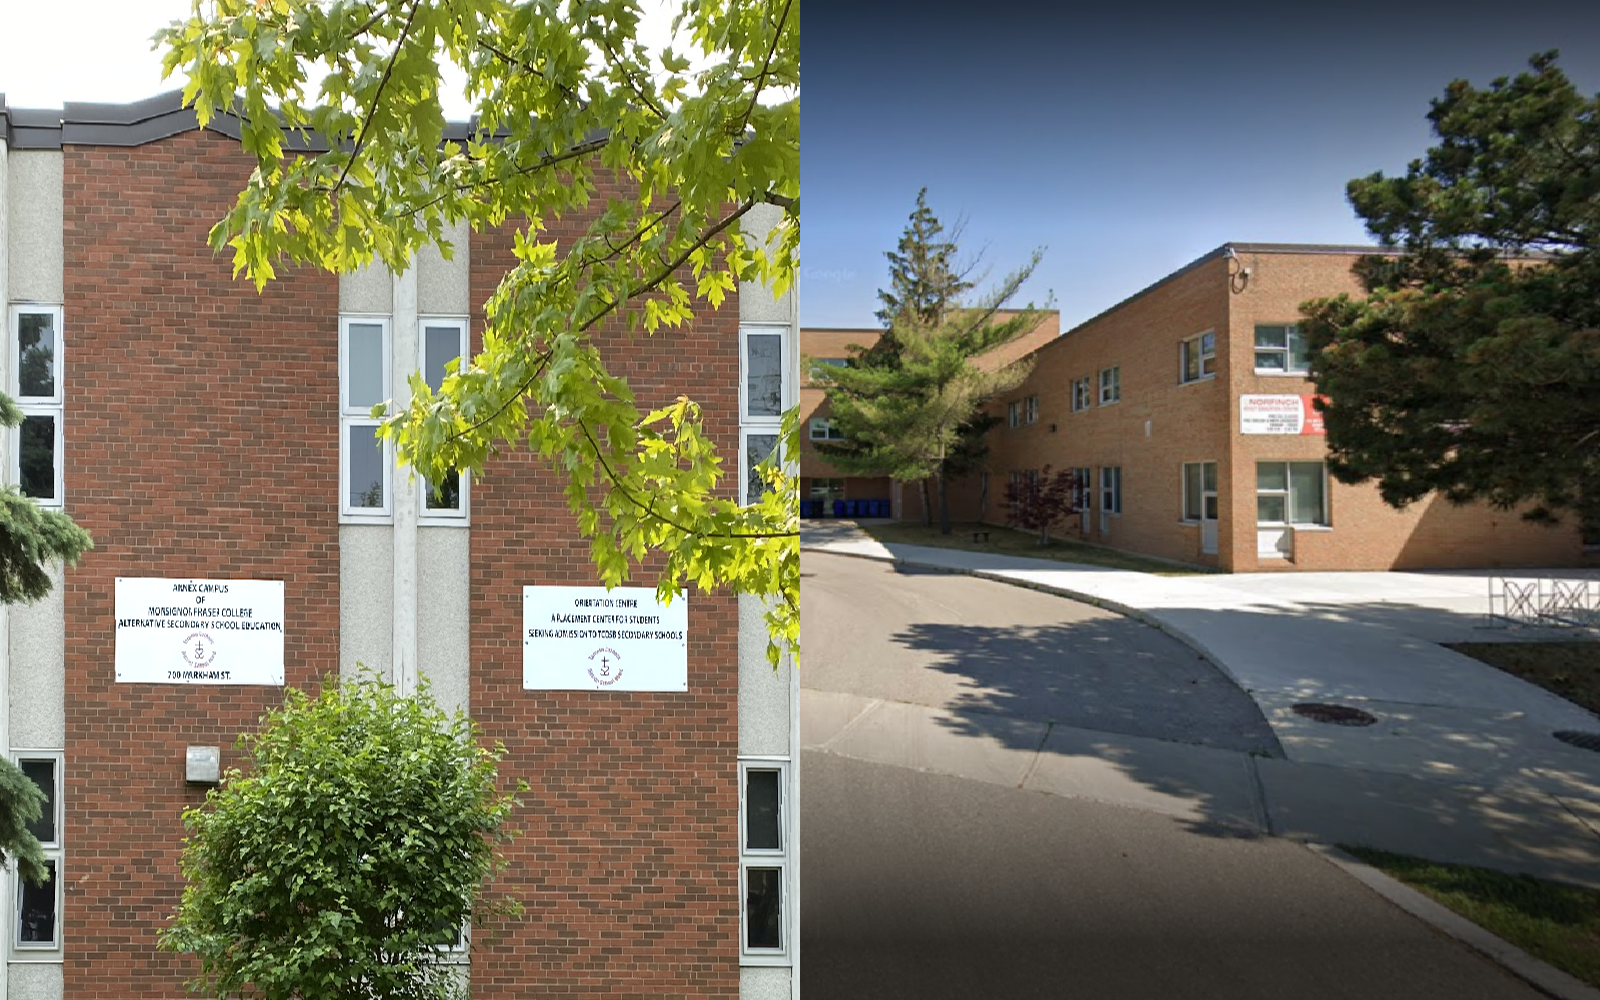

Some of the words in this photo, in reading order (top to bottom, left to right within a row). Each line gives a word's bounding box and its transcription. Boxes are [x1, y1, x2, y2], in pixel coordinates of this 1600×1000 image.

[172, 584, 198, 593] ANNEX
[198, 584, 229, 593] CAMPUS
[195, 595, 206, 604] OF
[221, 608, 253, 618] COLLEGE
[550, 613, 556, 623] A
[556, 613, 592, 623] PLACEMENT
[629, 615, 660, 625] STUDENTS
[117, 619, 166, 629] ALTERNATIVE
[166, 620, 210, 629] SECONDARY
[210, 621, 240, 630] SCHOOL
[241, 621, 281, 630] EDUCATION
[528, 629, 554, 638] SEEKING
[554, 629, 588, 639] ADMISSION
[588, 629, 597, 639] TO
[617, 630, 654, 640] SECONDARY
[654, 630, 683, 640] SCHOOLS
[167, 670, 182, 680] 700
